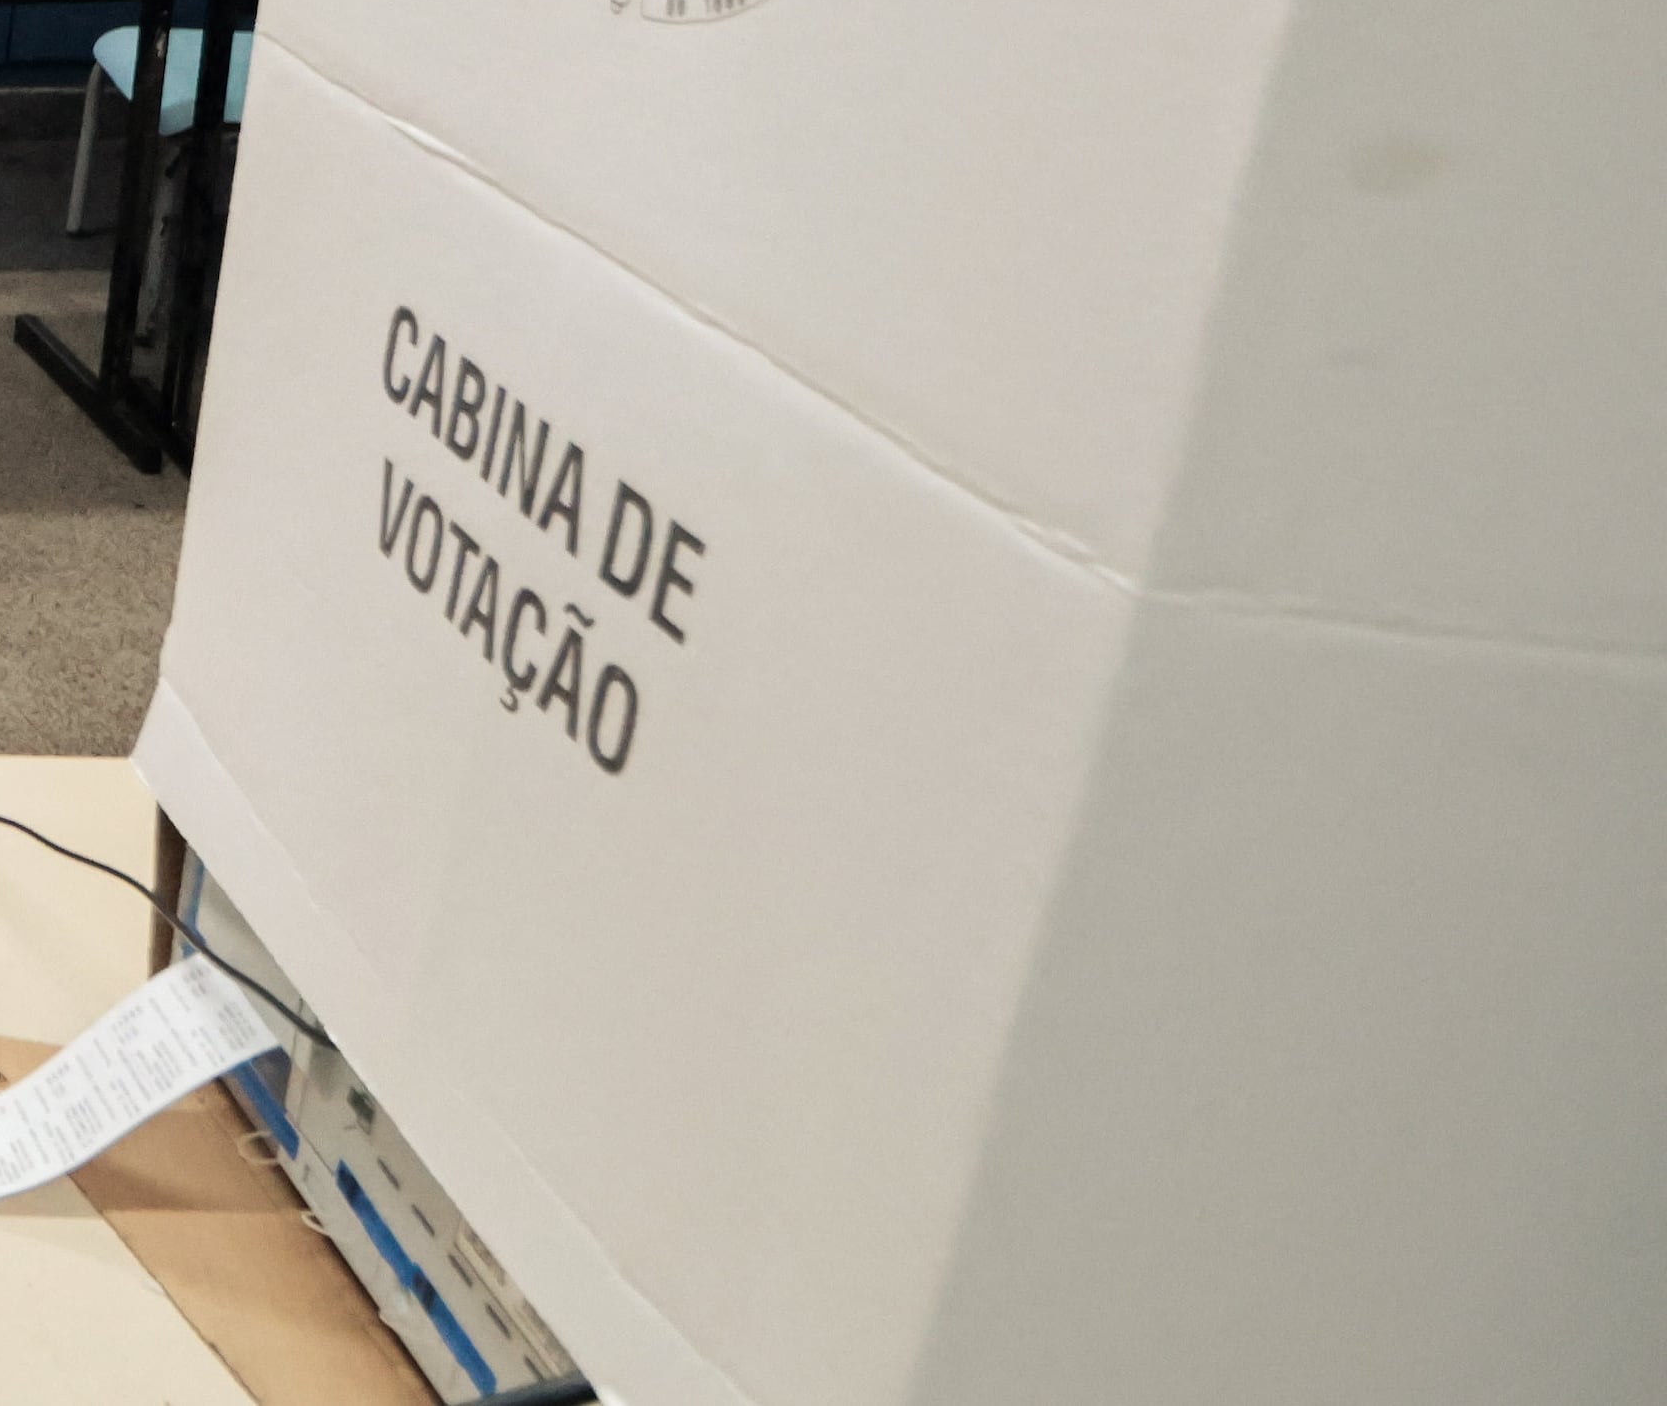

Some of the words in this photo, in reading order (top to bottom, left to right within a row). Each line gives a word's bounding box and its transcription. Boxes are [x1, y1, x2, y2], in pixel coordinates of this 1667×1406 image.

[379, 457, 639, 775] VOTAÇÃO
[383, 305, 585, 558] CABINA
[599, 479, 706, 645] DE
